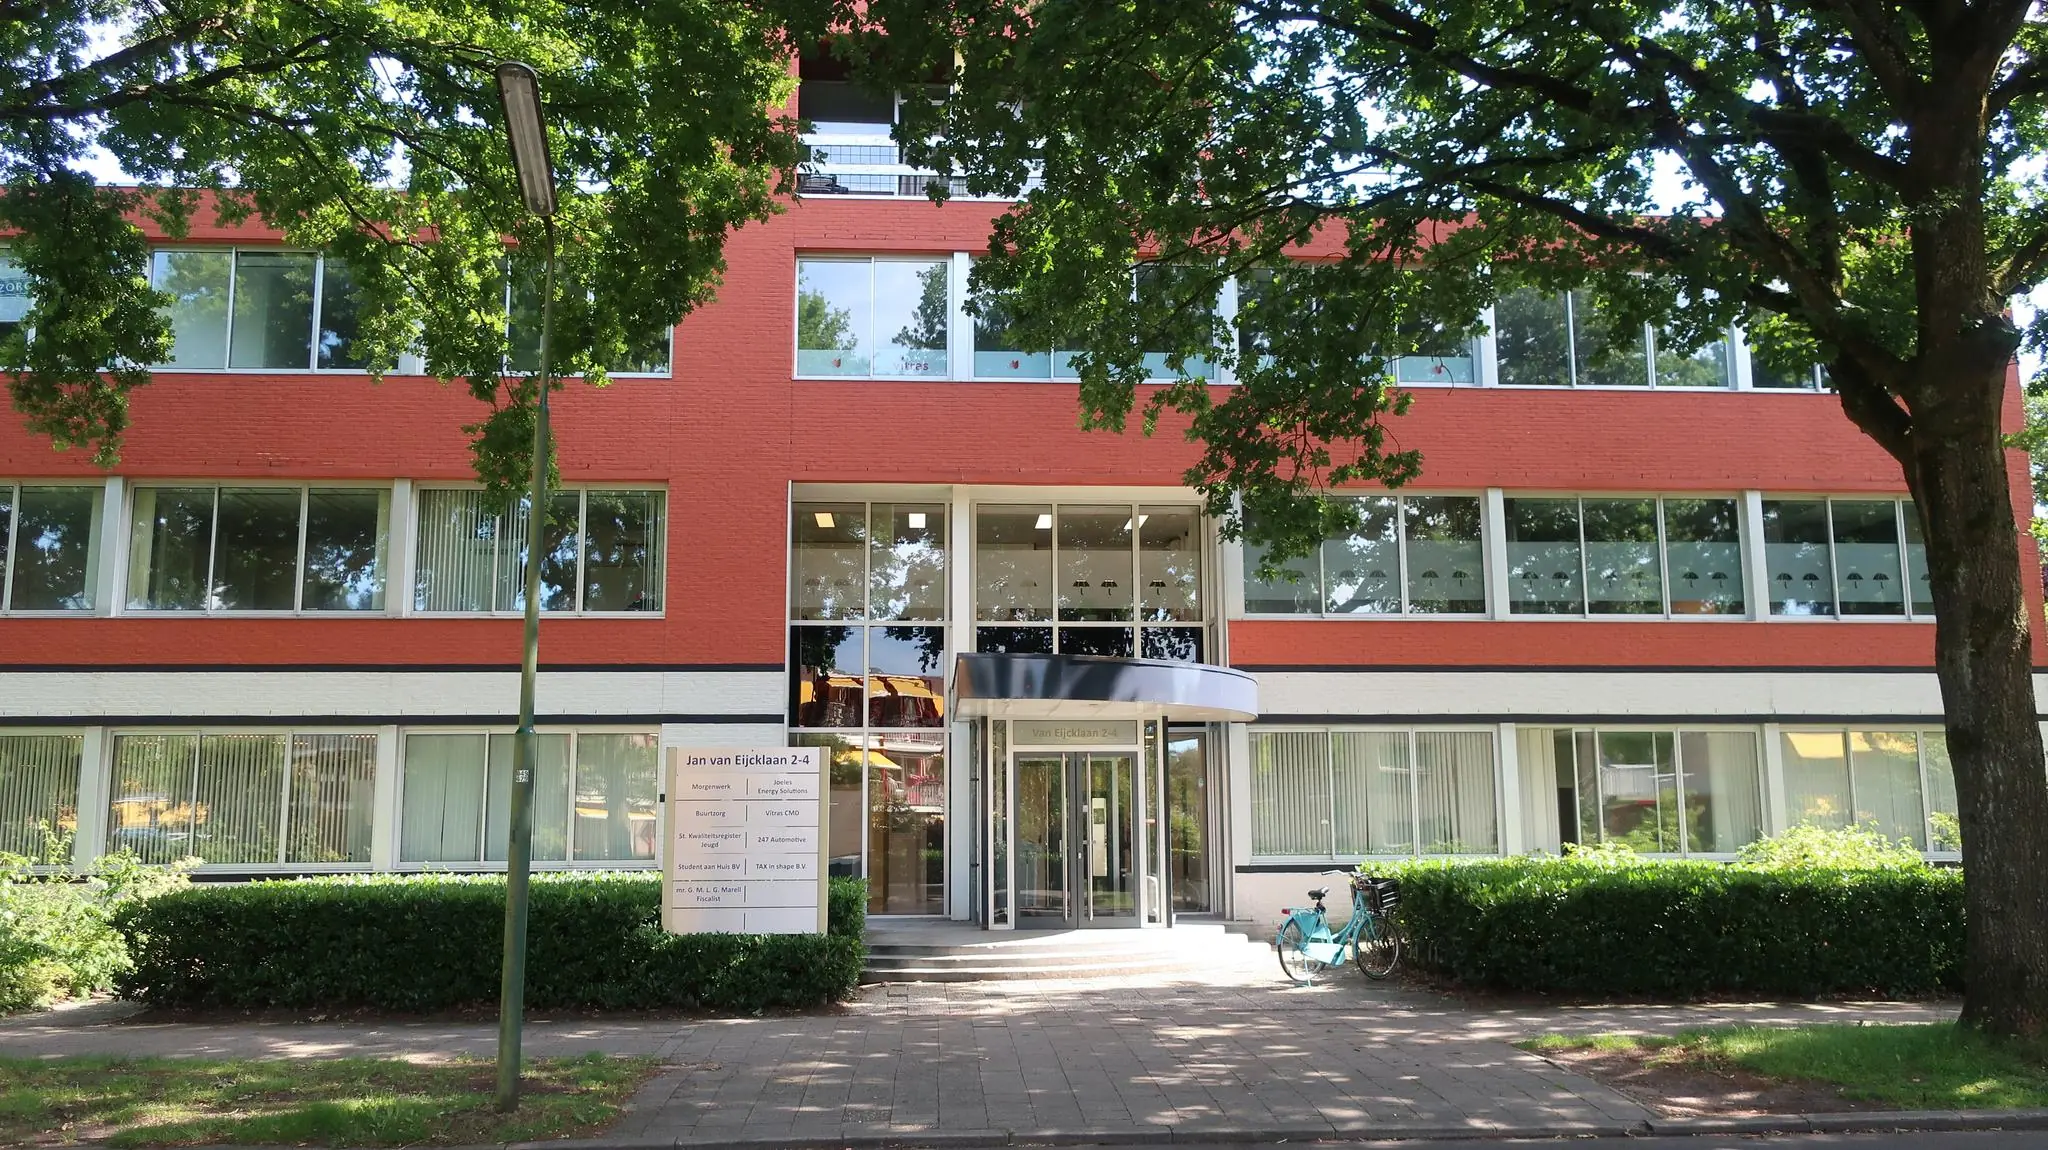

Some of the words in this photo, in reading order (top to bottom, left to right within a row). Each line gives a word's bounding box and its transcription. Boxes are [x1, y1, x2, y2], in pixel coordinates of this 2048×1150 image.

[1032, 728, 1051, 737] Van
[1054, 728, 1099, 739] Eijcklaan
[1101, 728, 1117, 737] 2-4
[686, 755, 706, 766] Jan
[710, 757, 731, 766] van
[735, 754, 787, 767] Eijcklaan
[790, 754, 810, 765] 2-4
[692, 783, 731, 791] Morgenwerk
[780, 787, 808, 795] Solutions
[688, 832, 742, 840] Kwaliteitsregister
[776, 863, 795, 871] shape
